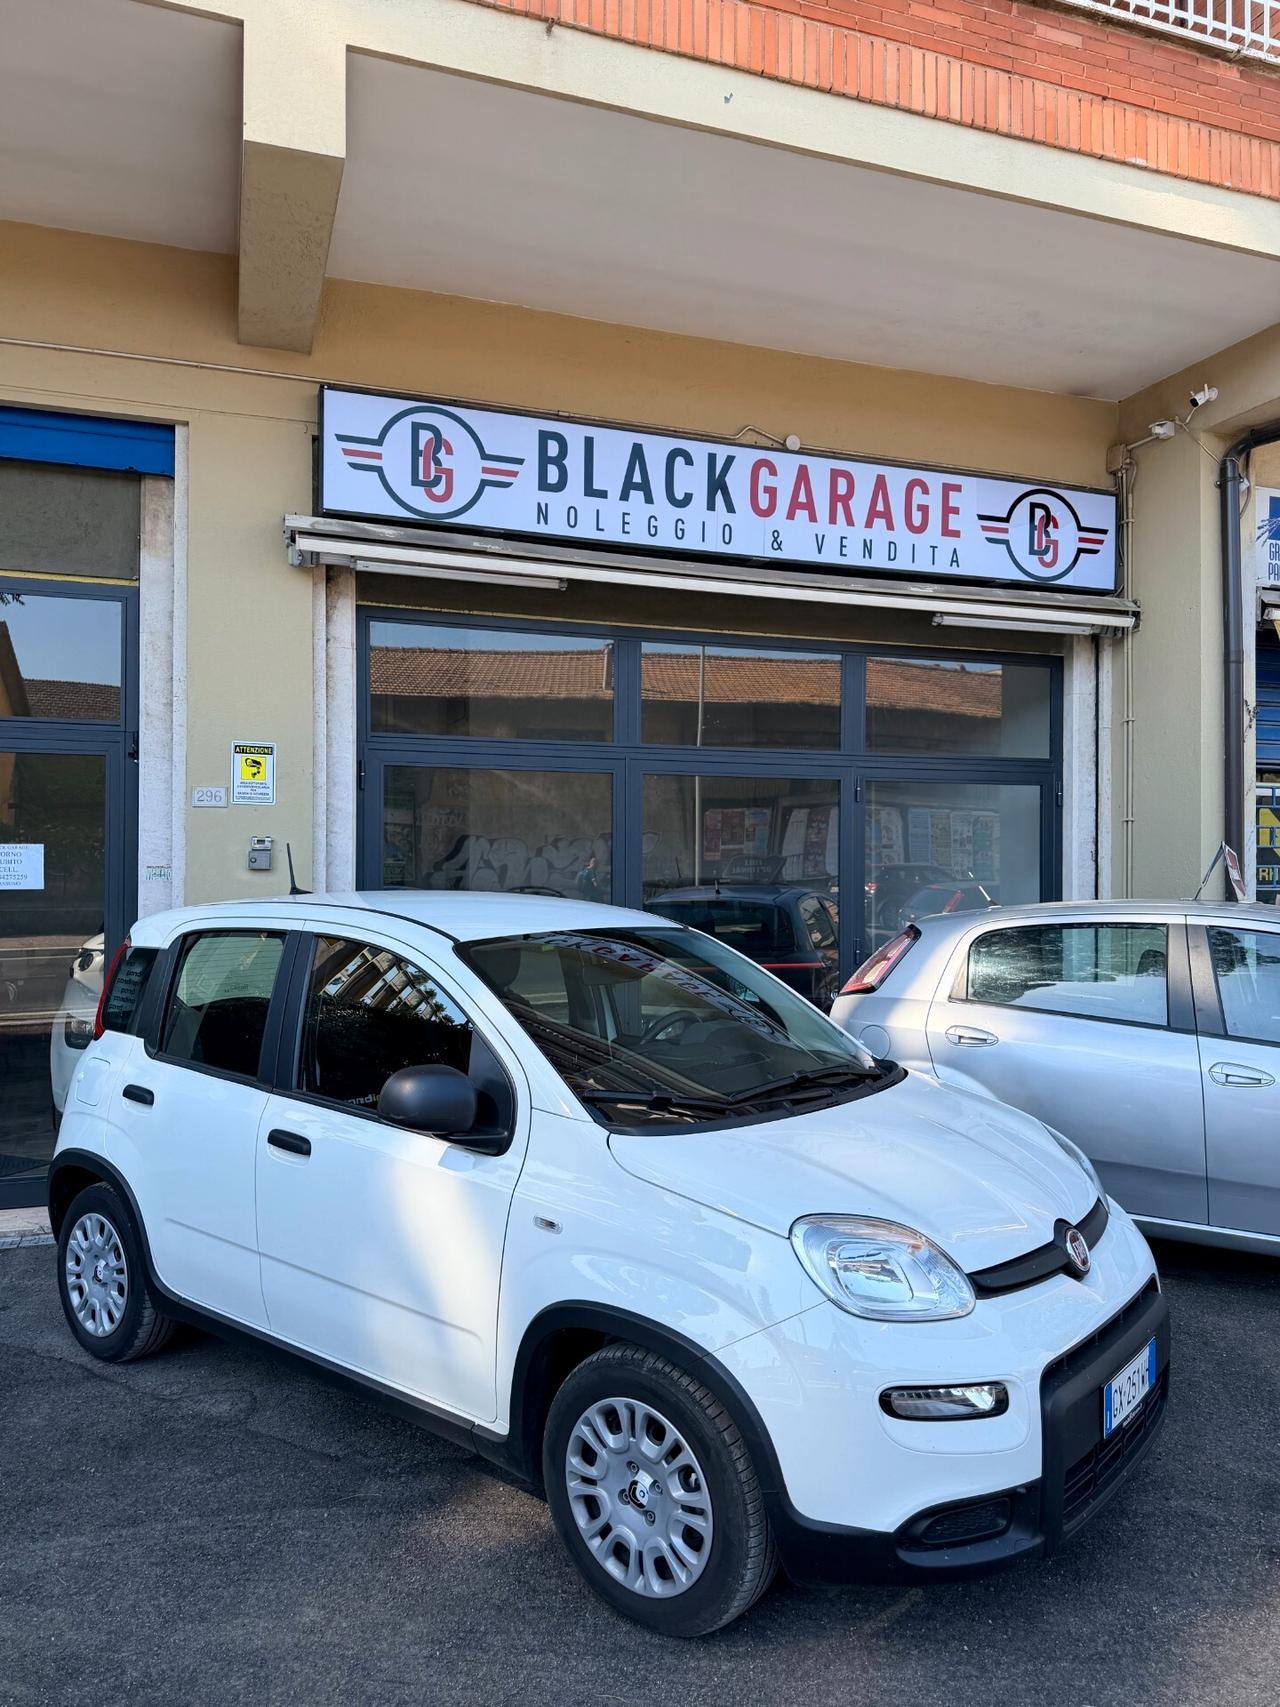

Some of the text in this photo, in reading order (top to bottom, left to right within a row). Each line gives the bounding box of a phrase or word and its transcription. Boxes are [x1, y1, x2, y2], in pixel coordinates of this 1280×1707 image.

[537, 502, 960, 568] NOLEGGIO & VENDITA
[1269, 562, 1280, 581] PA
[235, 746, 273, 754] ATTENZIONE
[197, 790, 222, 803] 296
